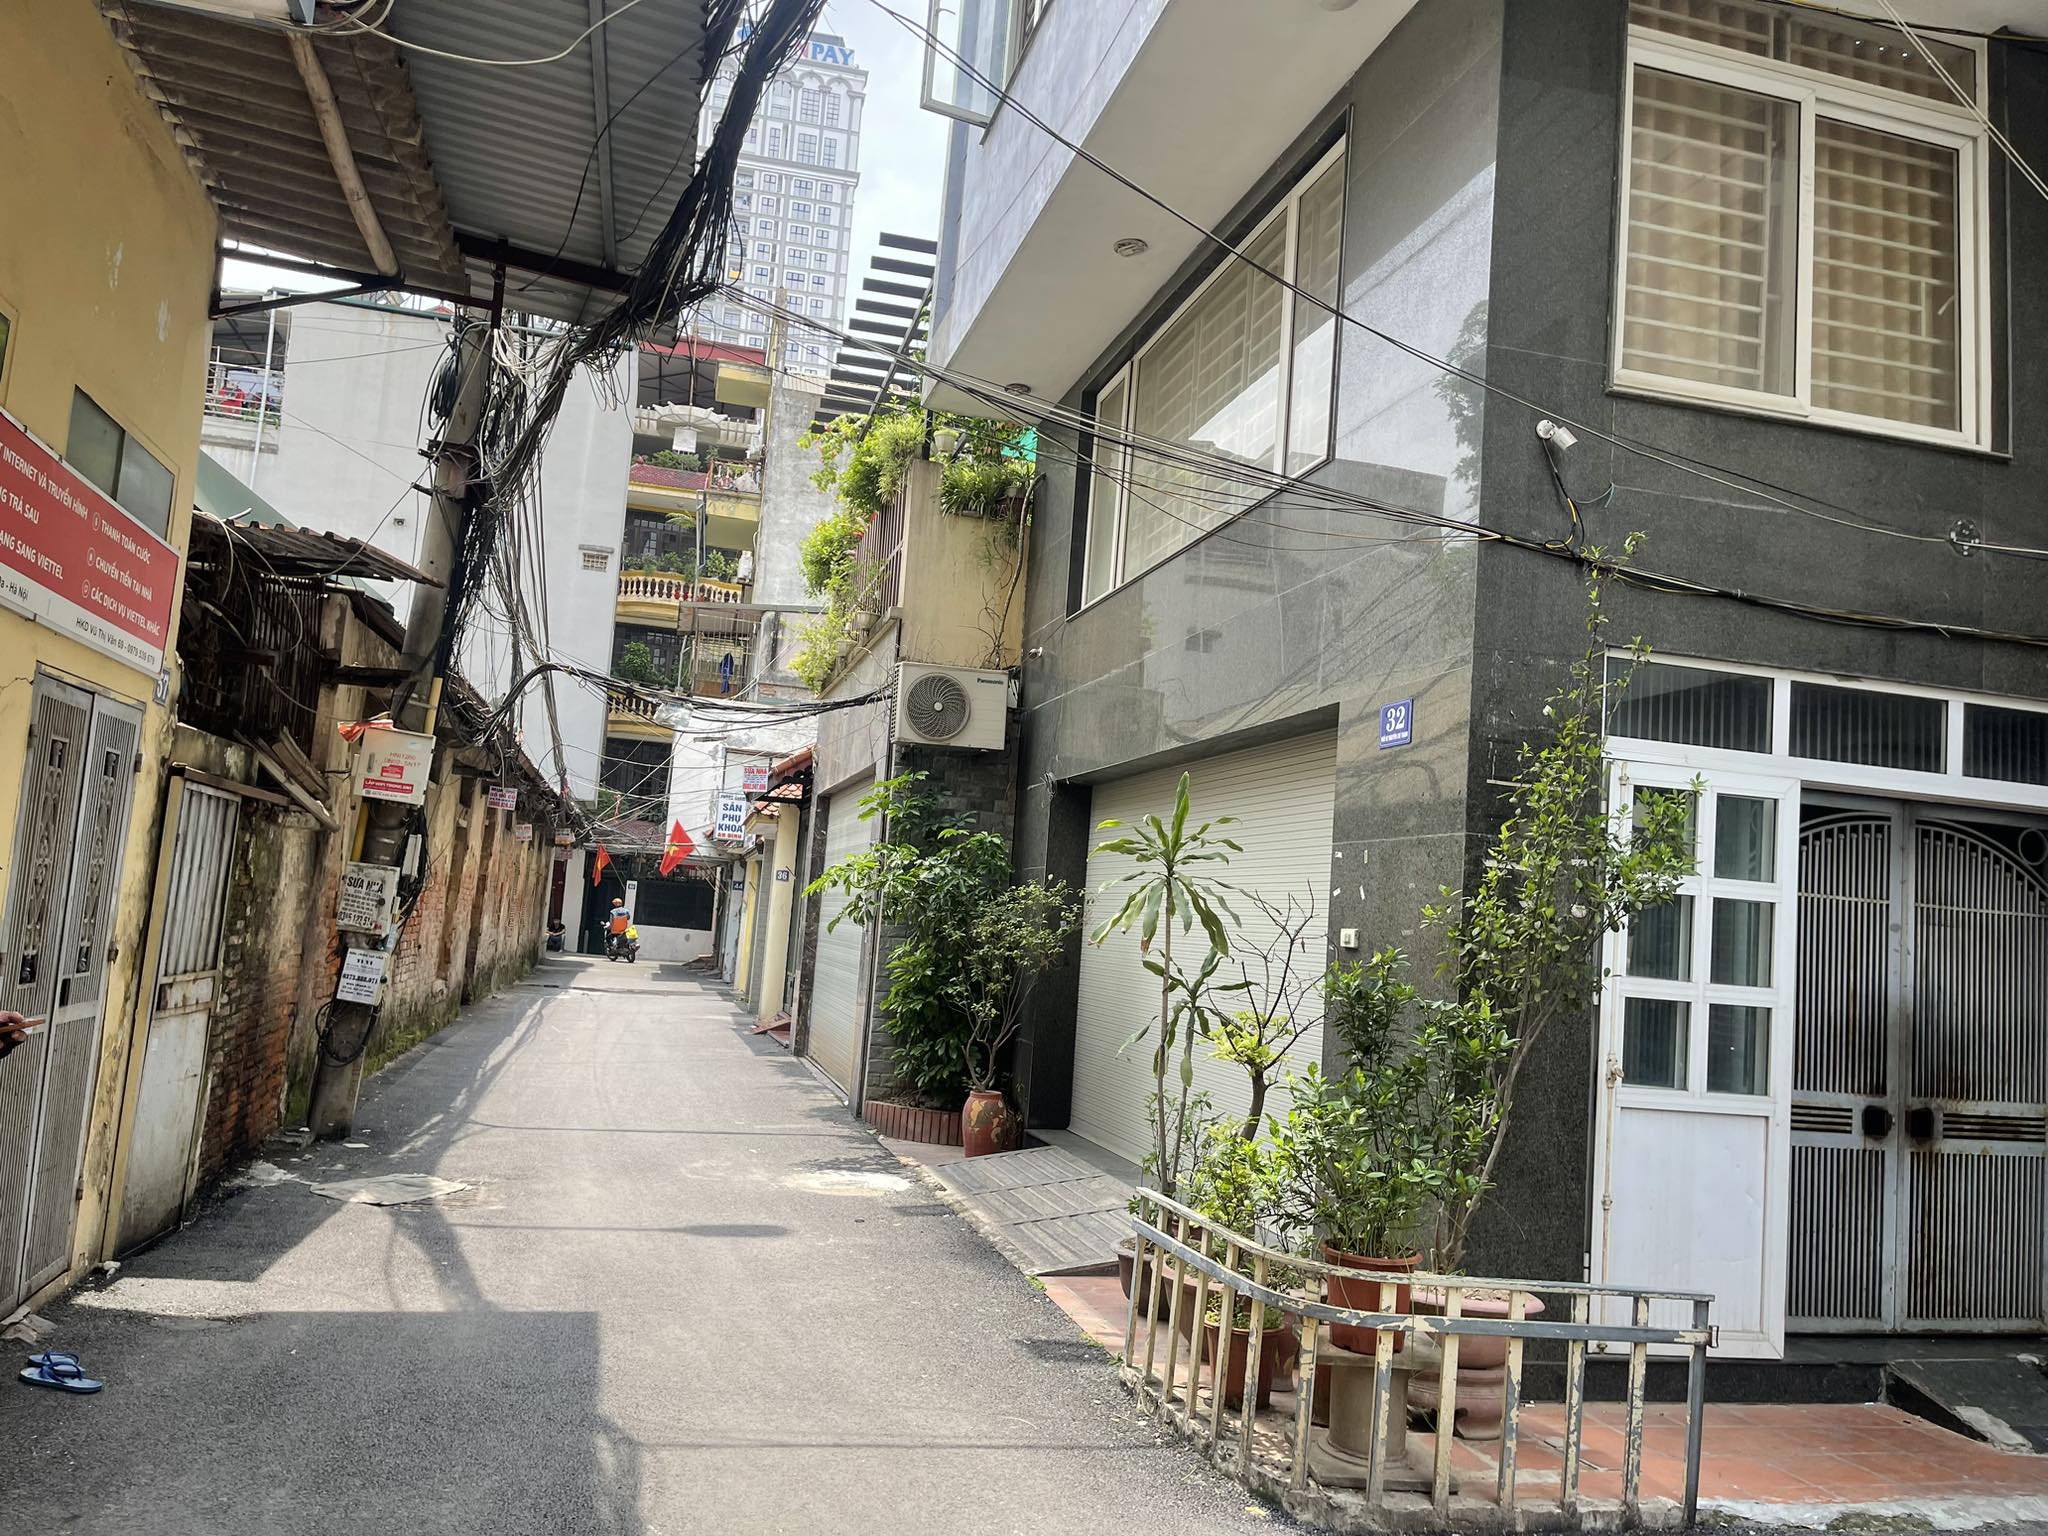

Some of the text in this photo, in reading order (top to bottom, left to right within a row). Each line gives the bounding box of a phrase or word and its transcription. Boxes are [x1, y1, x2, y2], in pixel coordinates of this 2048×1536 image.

[812, 43, 855, 66] PAY
[3, 450, 37, 482] INTERNET
[38, 472, 48, 491] VÀ
[24, 505, 40, 525] SAU
[101, 520, 121, 543] THANH
[121, 534, 136, 554] TOÁN
[16, 540, 36, 563] SANG
[37, 552, 63, 580] VIETTEL
[91, 586, 103, 604] CÁC
[126, 608, 147, 629] VIETTEL
[76, 617, 90, 632] HKD
[1386, 705, 1405, 732] 32
[722, 801, 742, 812] SẢN
[718, 823, 743, 833] KHOA
[722, 813, 741, 824] PHỤ
[777, 871, 788, 880] 36
